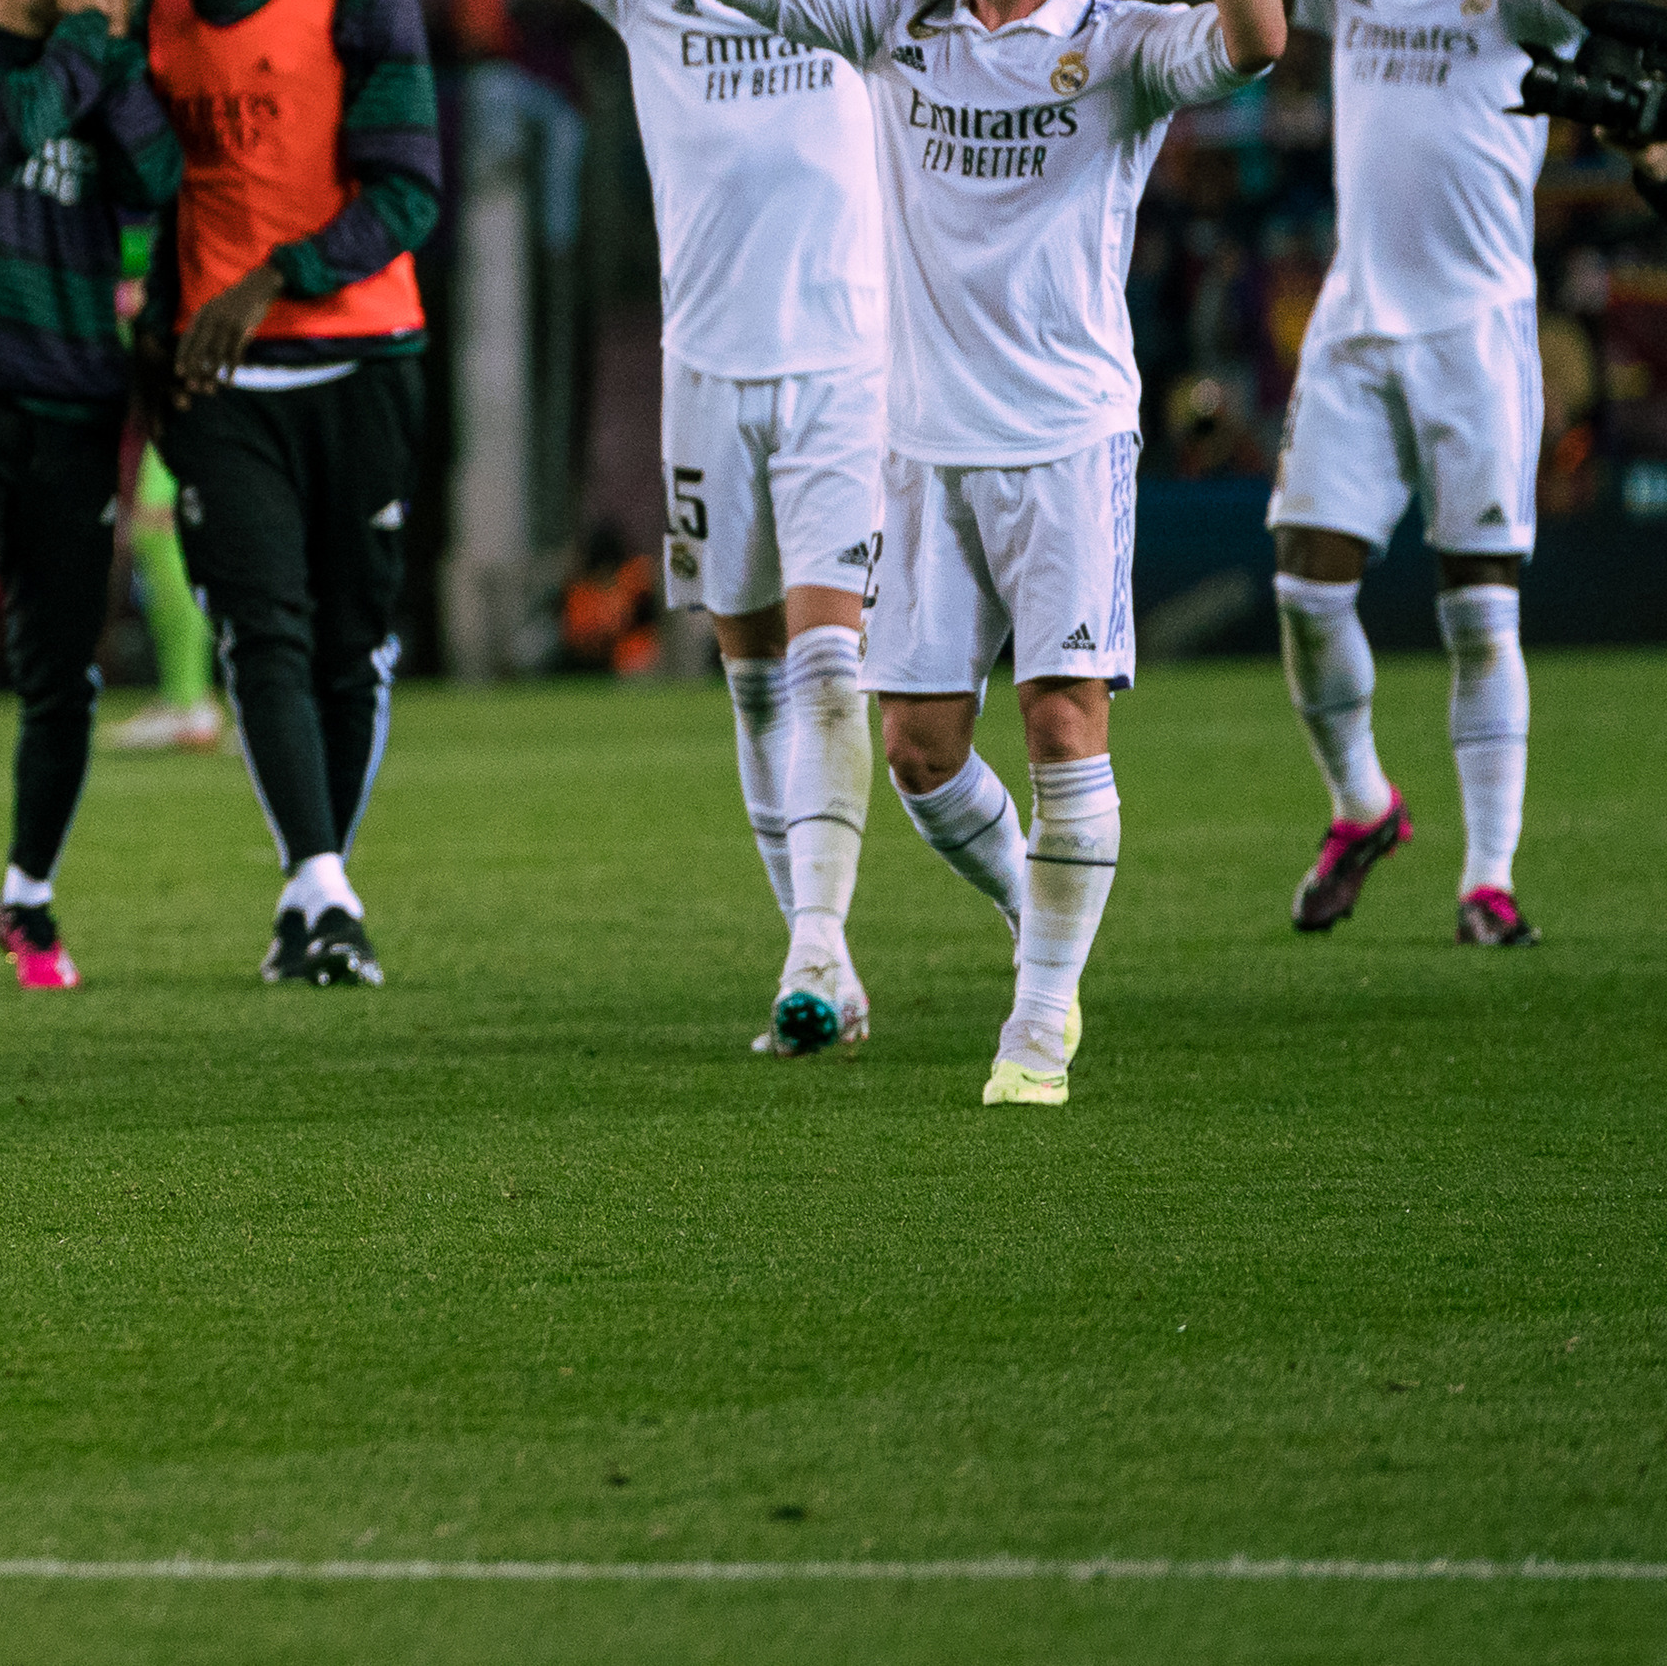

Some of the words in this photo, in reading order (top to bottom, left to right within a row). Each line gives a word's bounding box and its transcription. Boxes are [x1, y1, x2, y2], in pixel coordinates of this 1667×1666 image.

[681, 31, 814, 66] Emira
[706, 70, 742, 100] FLY
[752, 59, 833, 96] BETTER
[910, 88, 1078, 138] Emirates
[922, 138, 956, 172] FLY
[961, 144, 1046, 177] BETTER
